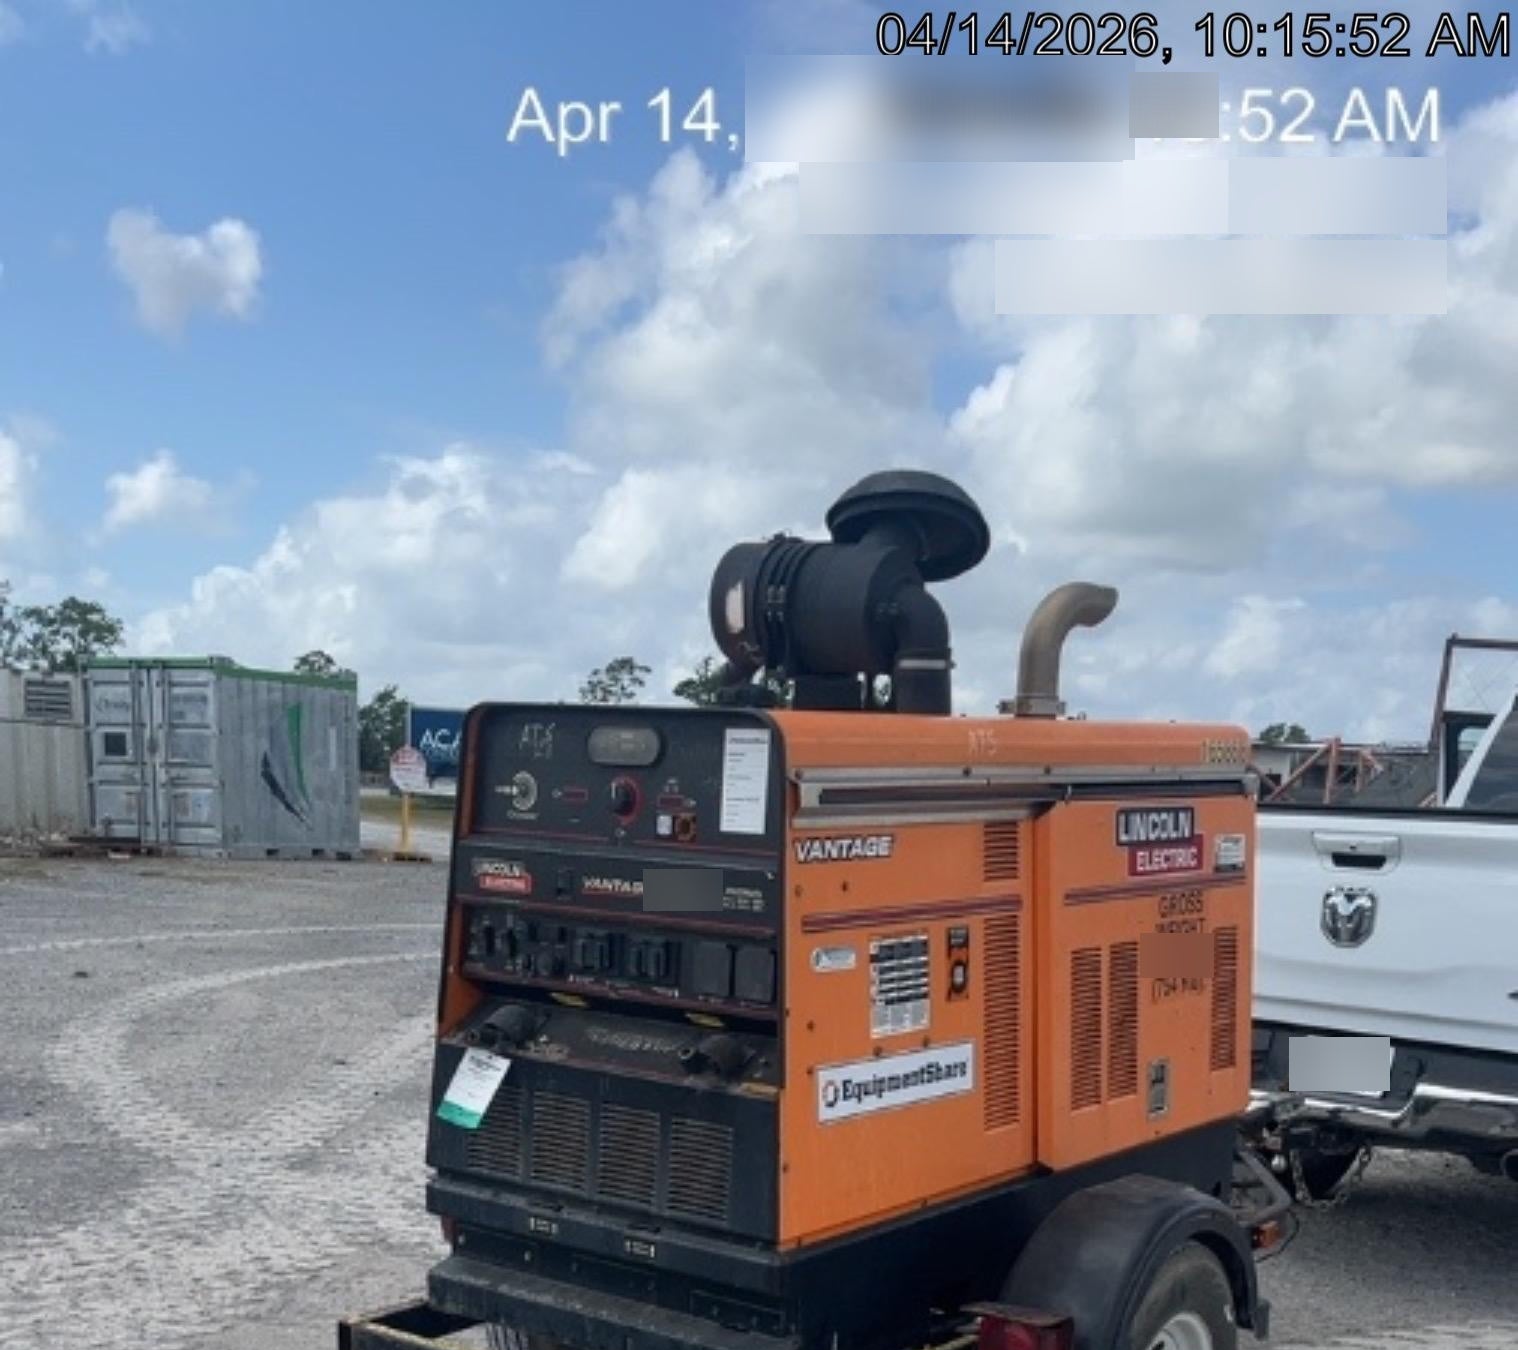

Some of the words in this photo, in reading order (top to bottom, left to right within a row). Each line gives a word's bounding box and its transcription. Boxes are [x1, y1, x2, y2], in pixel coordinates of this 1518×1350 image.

[1118, 810, 1192, 842] LINCOLN
[794, 834, 894, 863] VANTAGE
[1135, 846, 1199, 872] ELECTRIC
[842, 1061, 967, 1104] EquipmentShare
